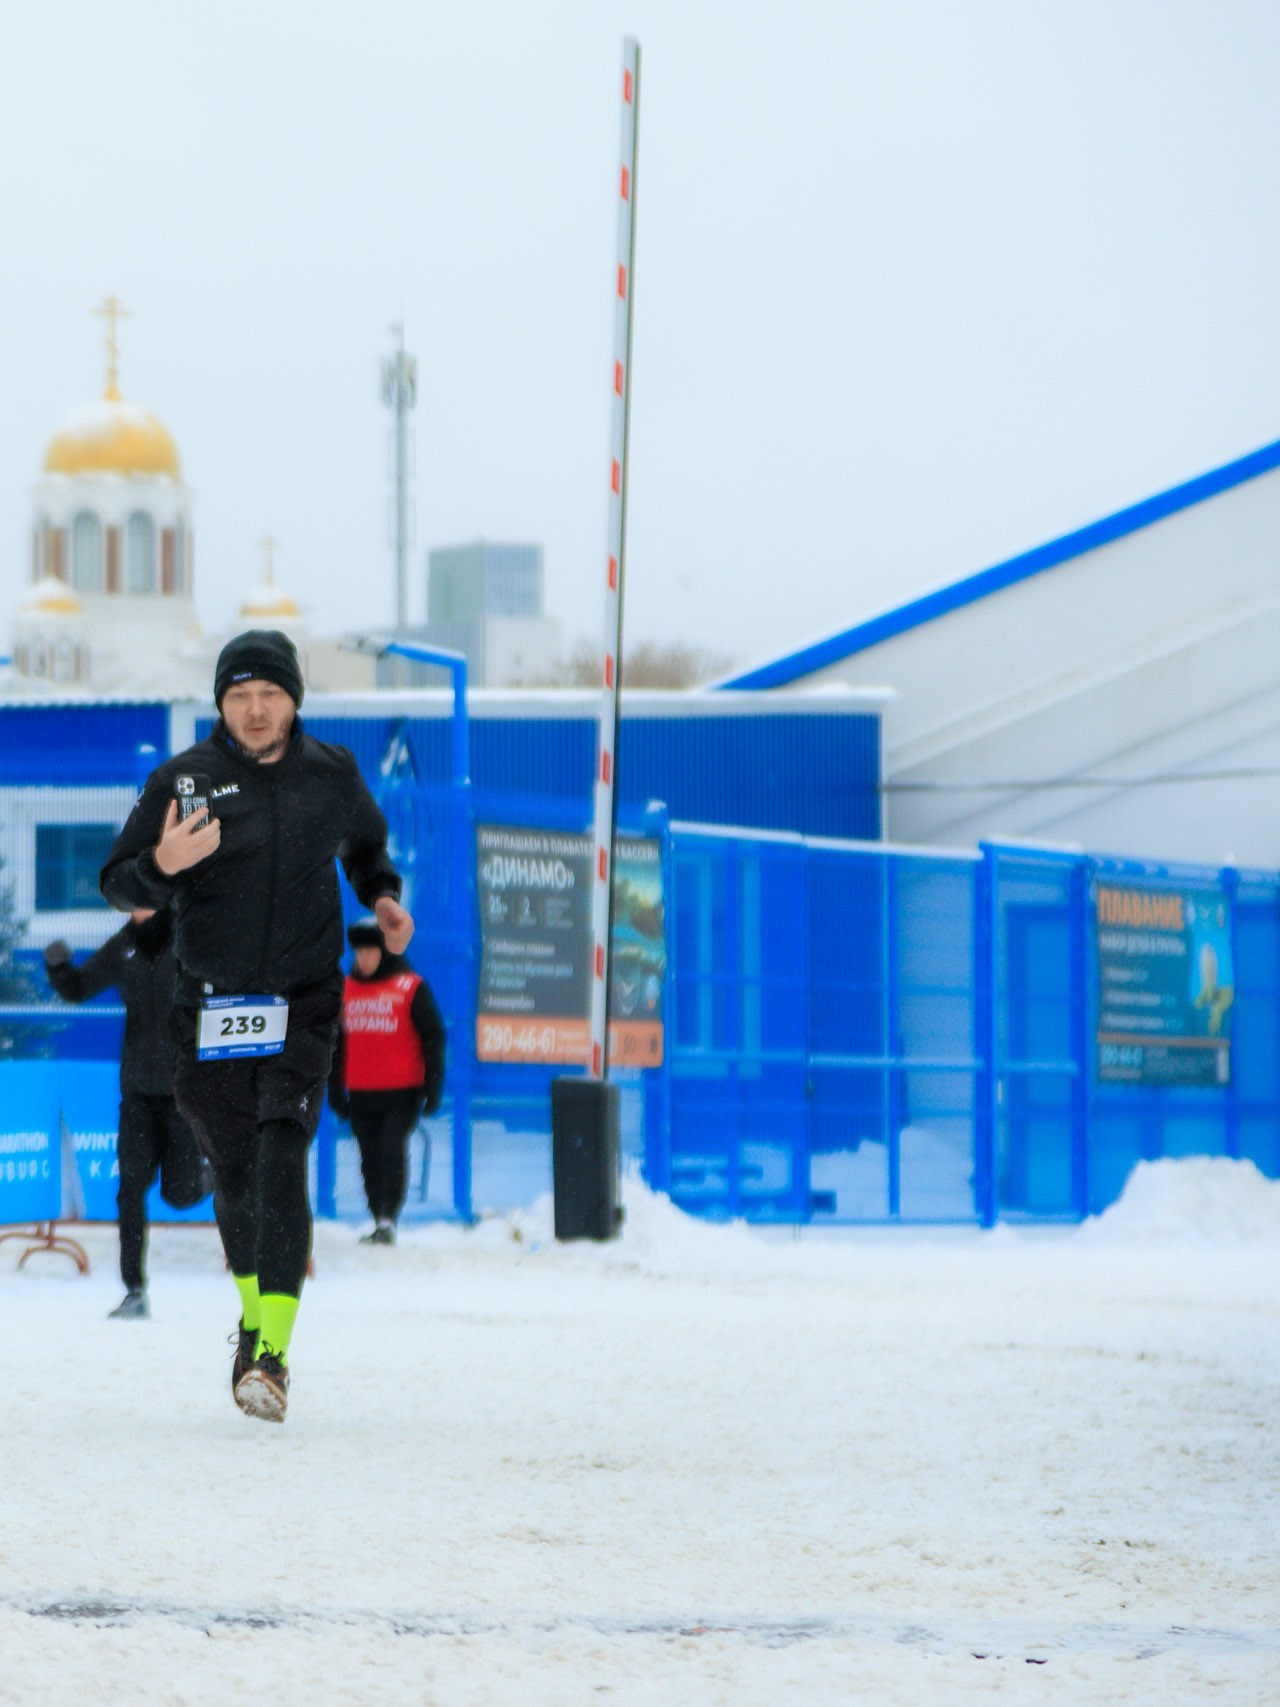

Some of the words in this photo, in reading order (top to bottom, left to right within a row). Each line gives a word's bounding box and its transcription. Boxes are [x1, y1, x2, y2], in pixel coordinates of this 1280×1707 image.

[213, 784, 240, 798] LME
[183, 803, 192, 813] TO
[483, 855, 575, 890] «ДИНАМО»
[348, 999, 393, 1015] СЛУЖБА
[221, 1015, 267, 1036] 239
[73, 1132, 120, 1152] WINT
